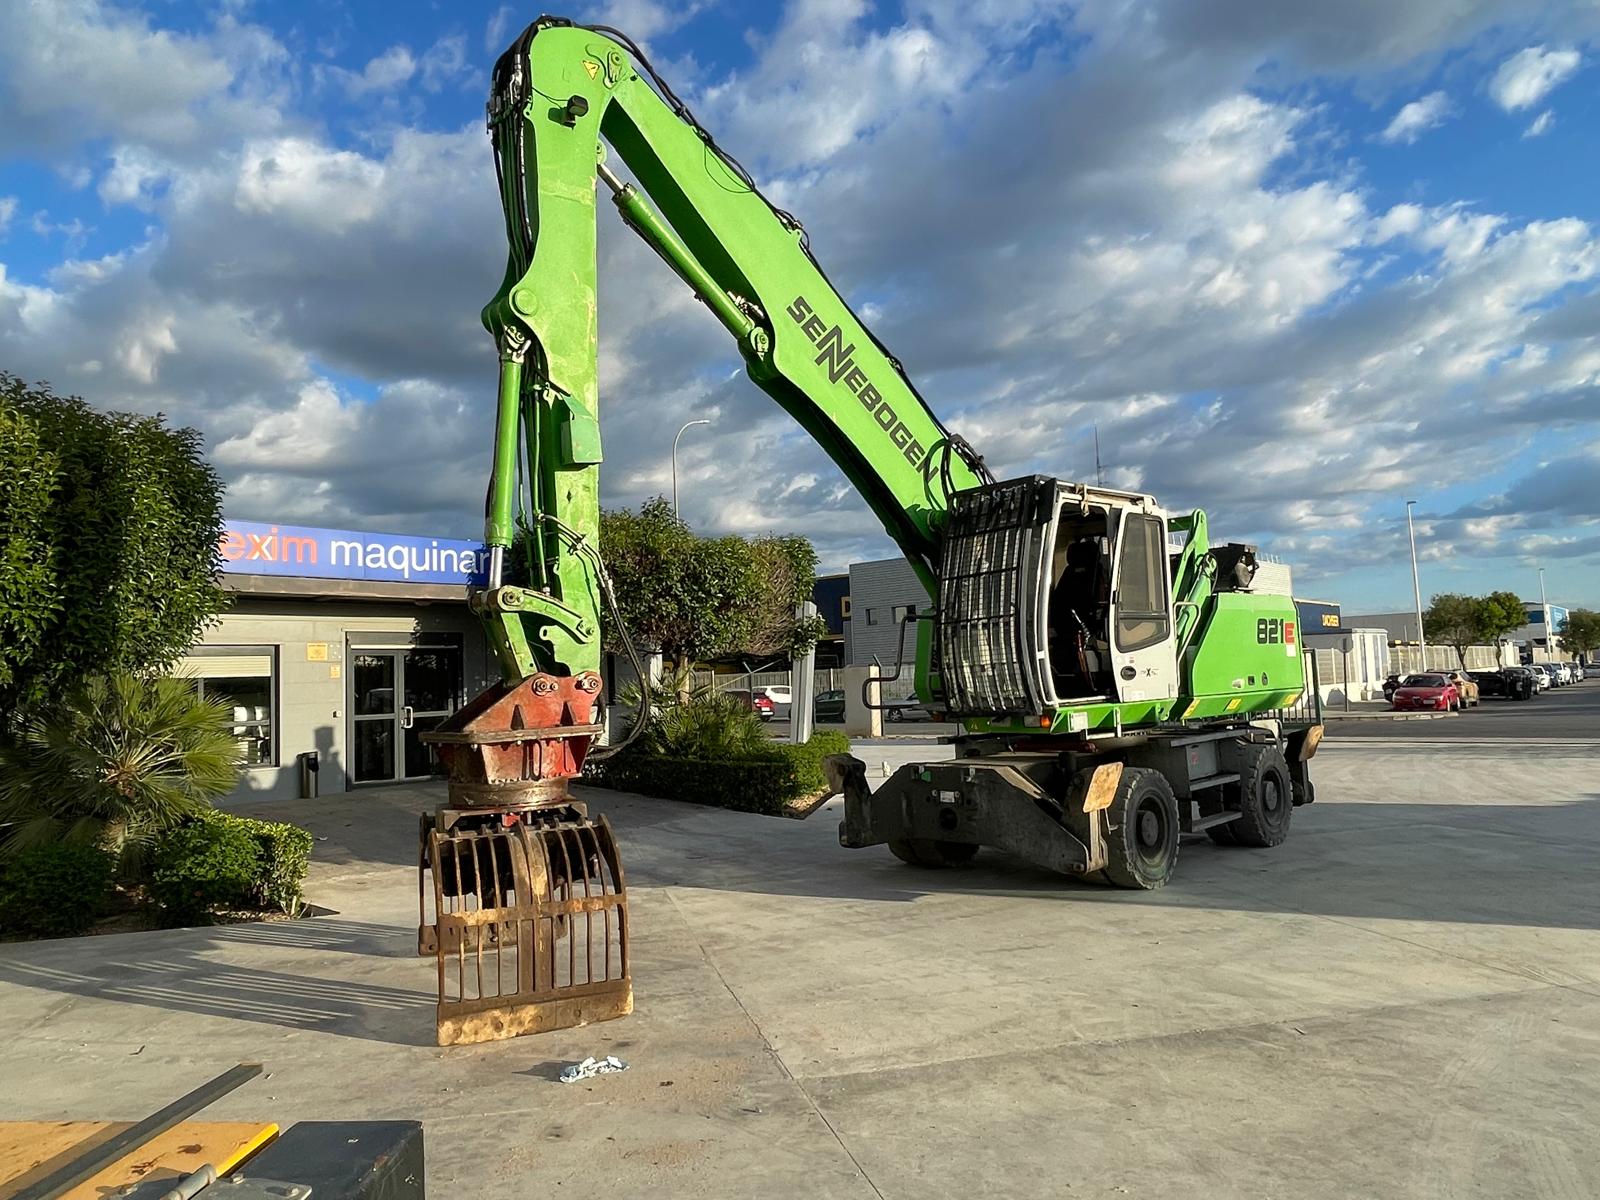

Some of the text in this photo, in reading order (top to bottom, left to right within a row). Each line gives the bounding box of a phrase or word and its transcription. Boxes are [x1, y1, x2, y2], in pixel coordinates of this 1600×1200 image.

[786, 295, 939, 482] SENNEBOGEN
[219, 526, 490, 579] exim maquinar
[1257, 618, 1296, 644] 821E
